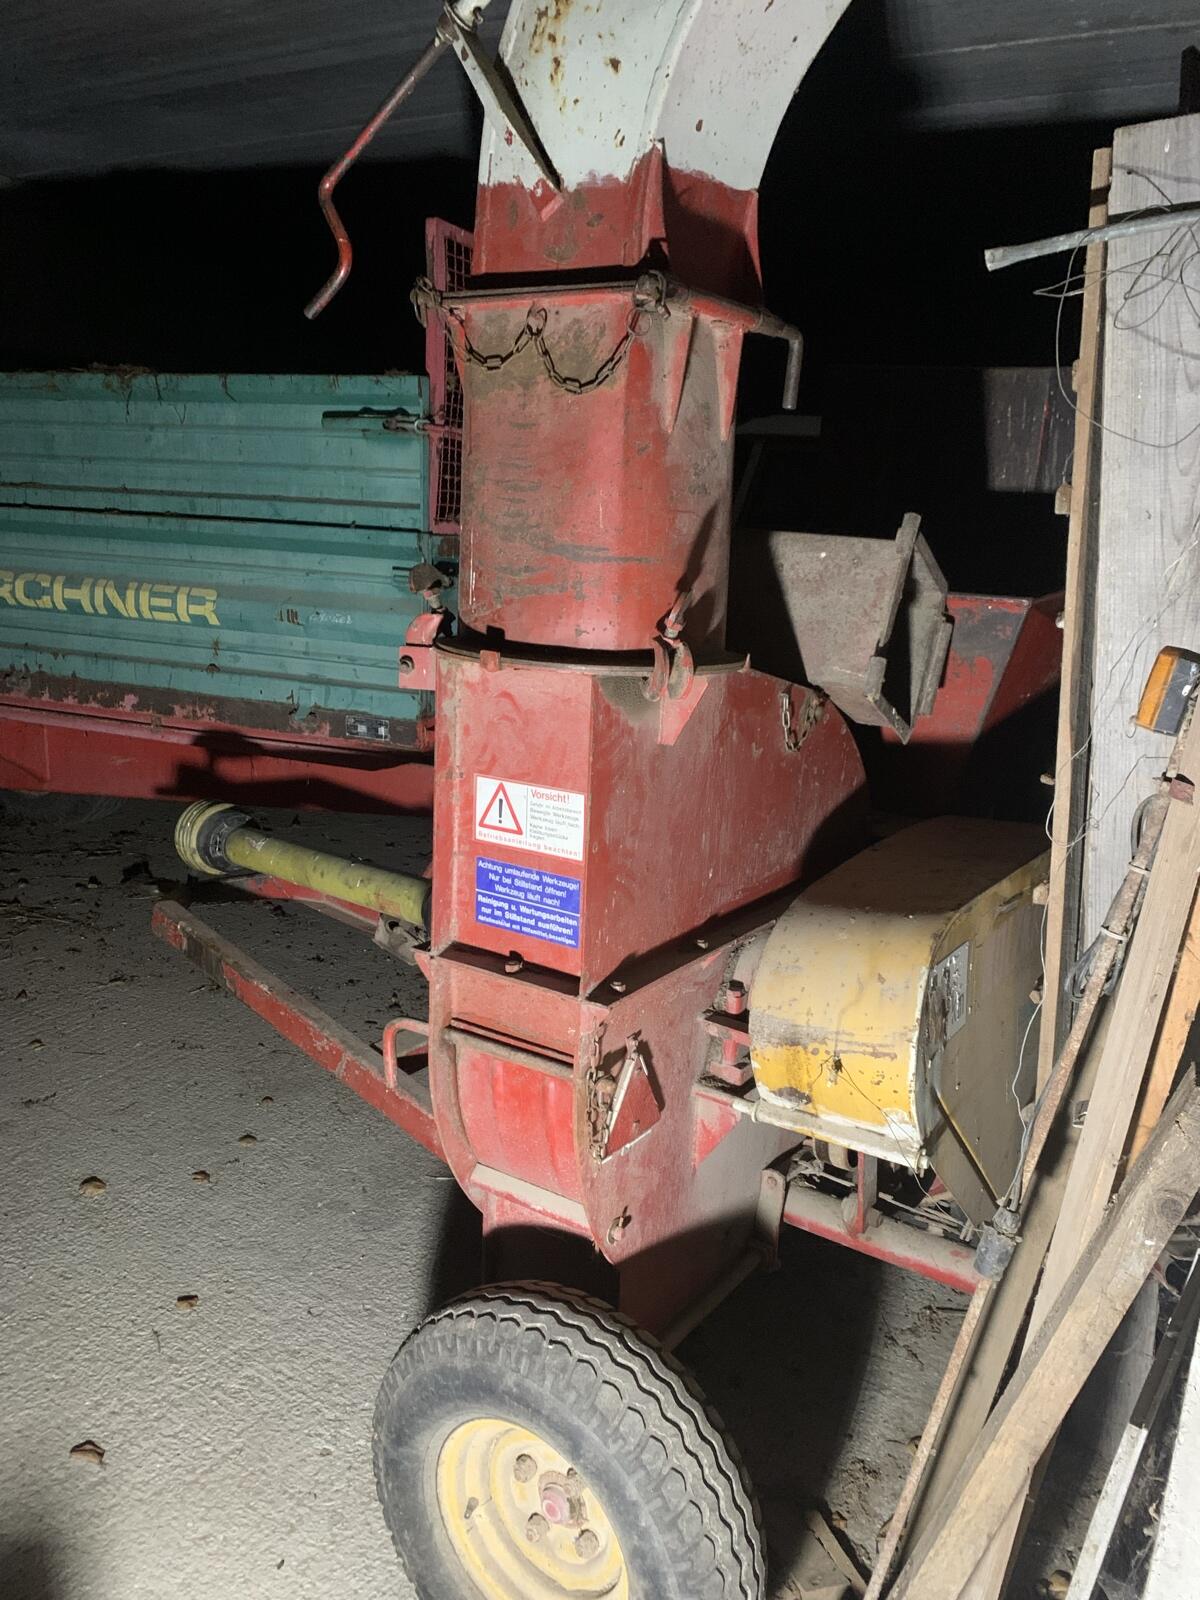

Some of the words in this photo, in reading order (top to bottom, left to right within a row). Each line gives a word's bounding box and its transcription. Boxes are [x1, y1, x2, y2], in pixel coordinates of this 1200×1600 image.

[531, 789, 569, 804] Vorsicht!
[479, 831, 540, 850] Betriebsanleitung
[478, 860, 502, 873] Achtung
[505, 867, 540, 881] umlaufende
[542, 875, 579, 890] Werkzeuge!
[489, 873, 500, 881] Nur
[502, 876, 511, 884] bei
[514, 878, 542, 892] Stillstand
[545, 886, 566, 898] öffnen!
[495, 884, 524, 899] Werkzeug
[527, 892, 540, 902] läuft
[543, 898, 560, 906] nach!
[478, 895, 508, 910] Reinigung
[520, 905, 577, 926] Wartungsarbeiten
[481, 906, 492, 914] nur
[505, 912, 535, 926] Stillstand
[538, 921, 573, 936] ausführen!
